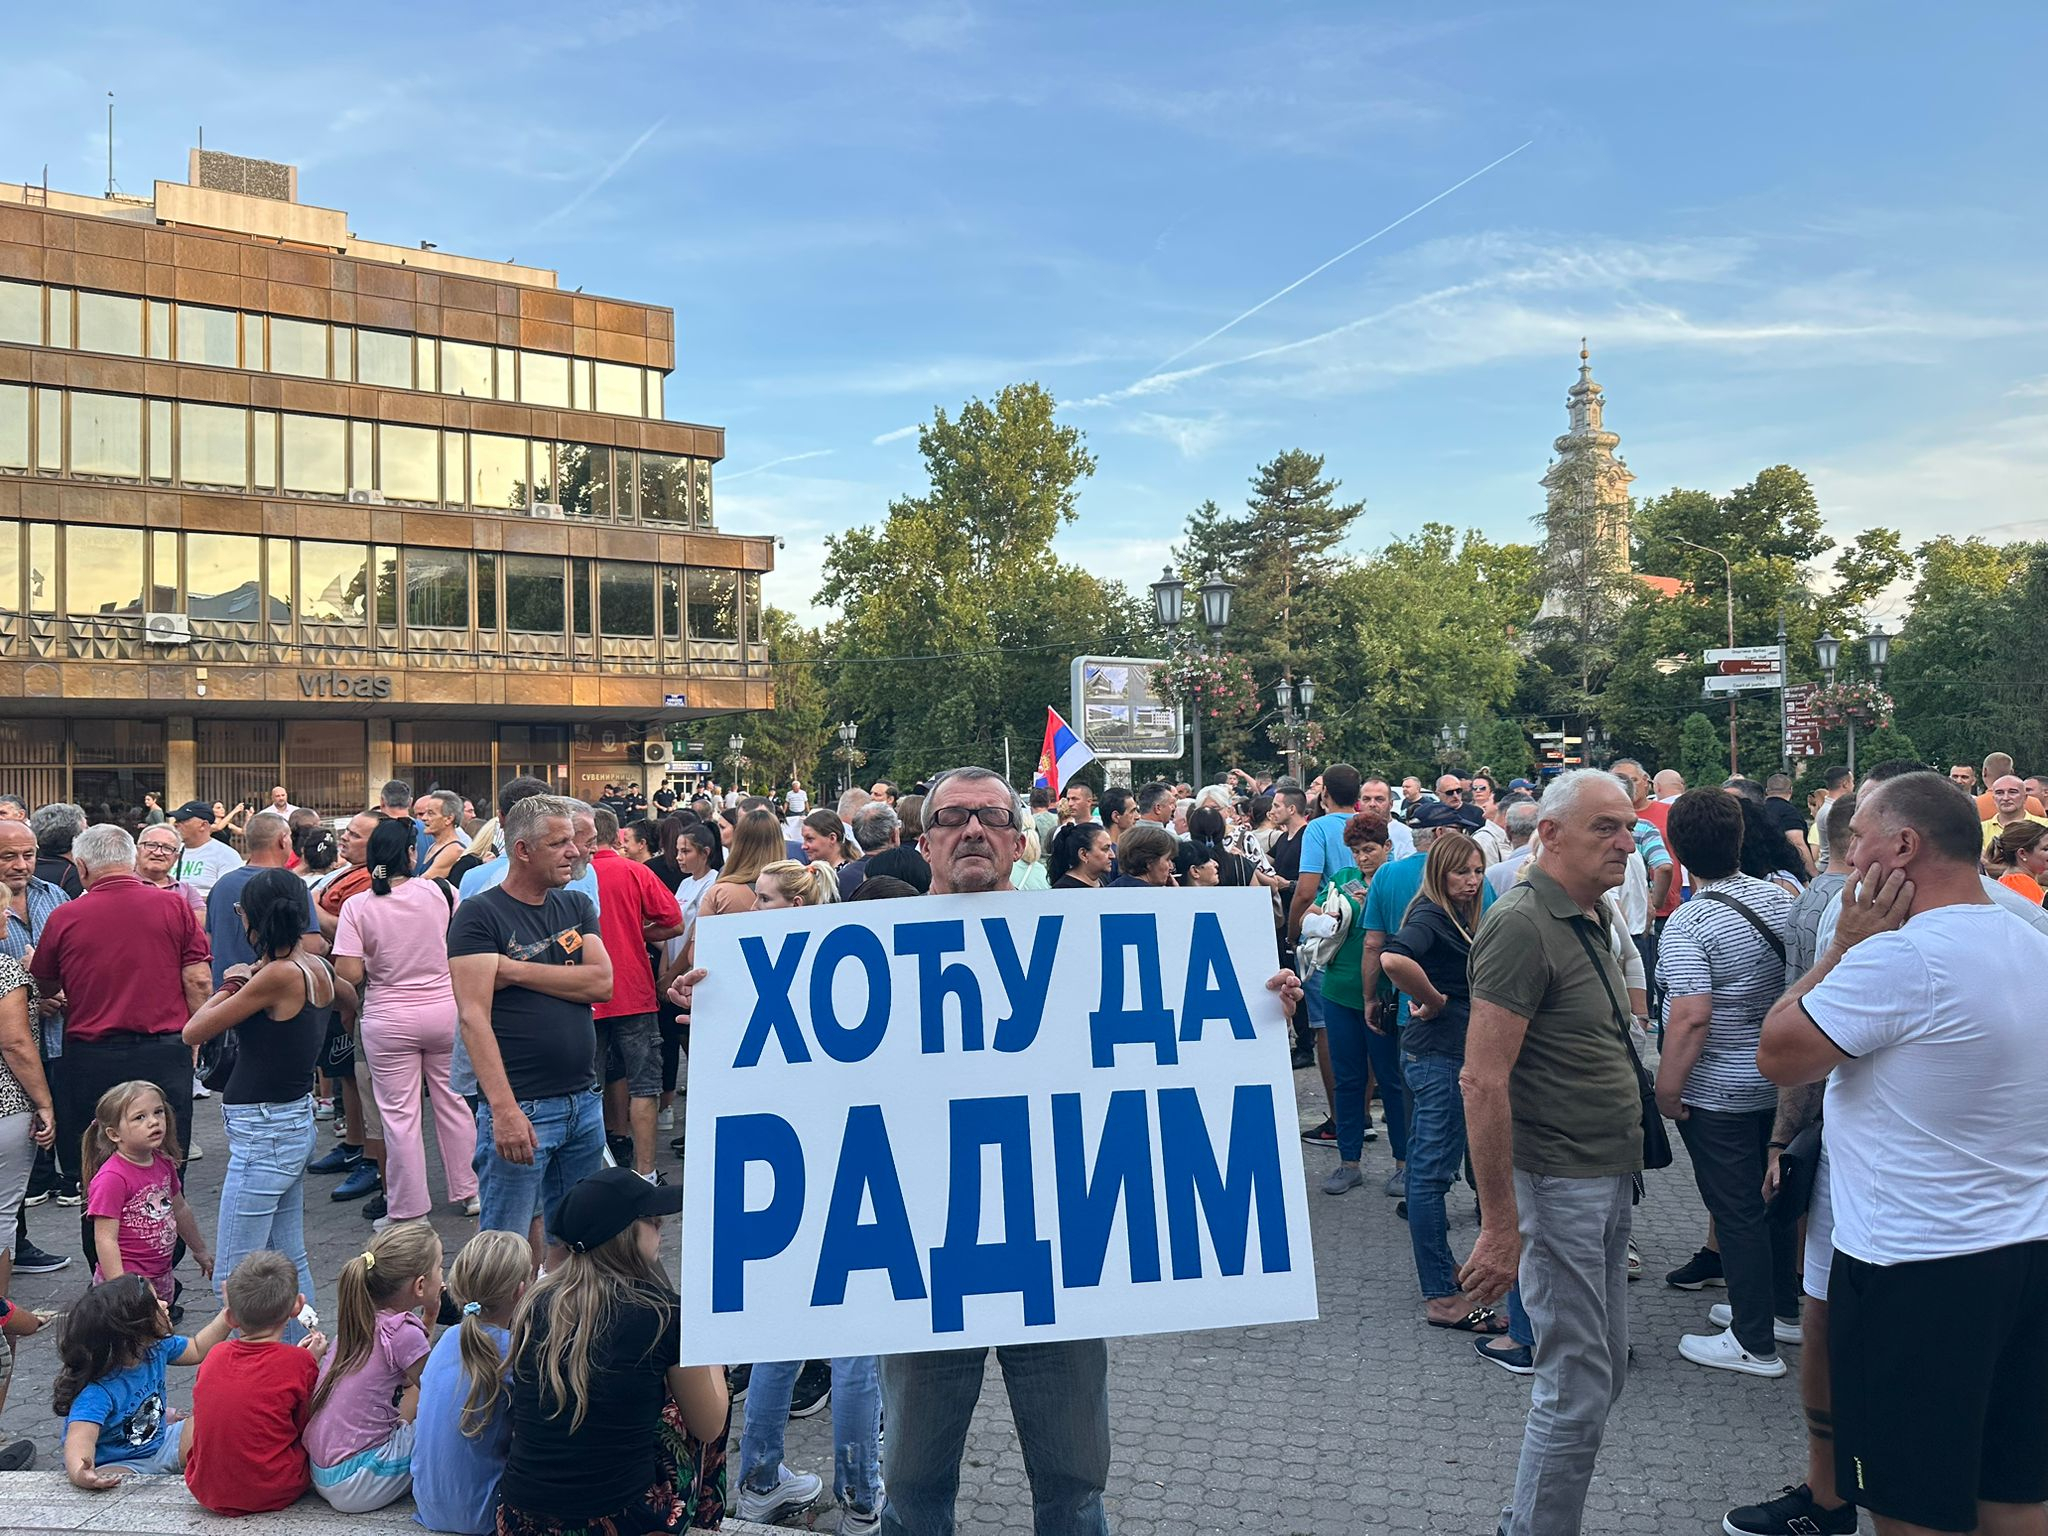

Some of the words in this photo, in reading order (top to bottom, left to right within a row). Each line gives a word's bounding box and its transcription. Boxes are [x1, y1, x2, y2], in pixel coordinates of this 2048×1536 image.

[299, 671, 391, 698] vrbas
[581, 773, 636, 781] СУВЕНИРНИЦА
[732, 915, 1064, 1068] ХОЋУ
[1089, 913, 1256, 1068] ДА
[713, 1085, 1291, 1333] РАДИМ
